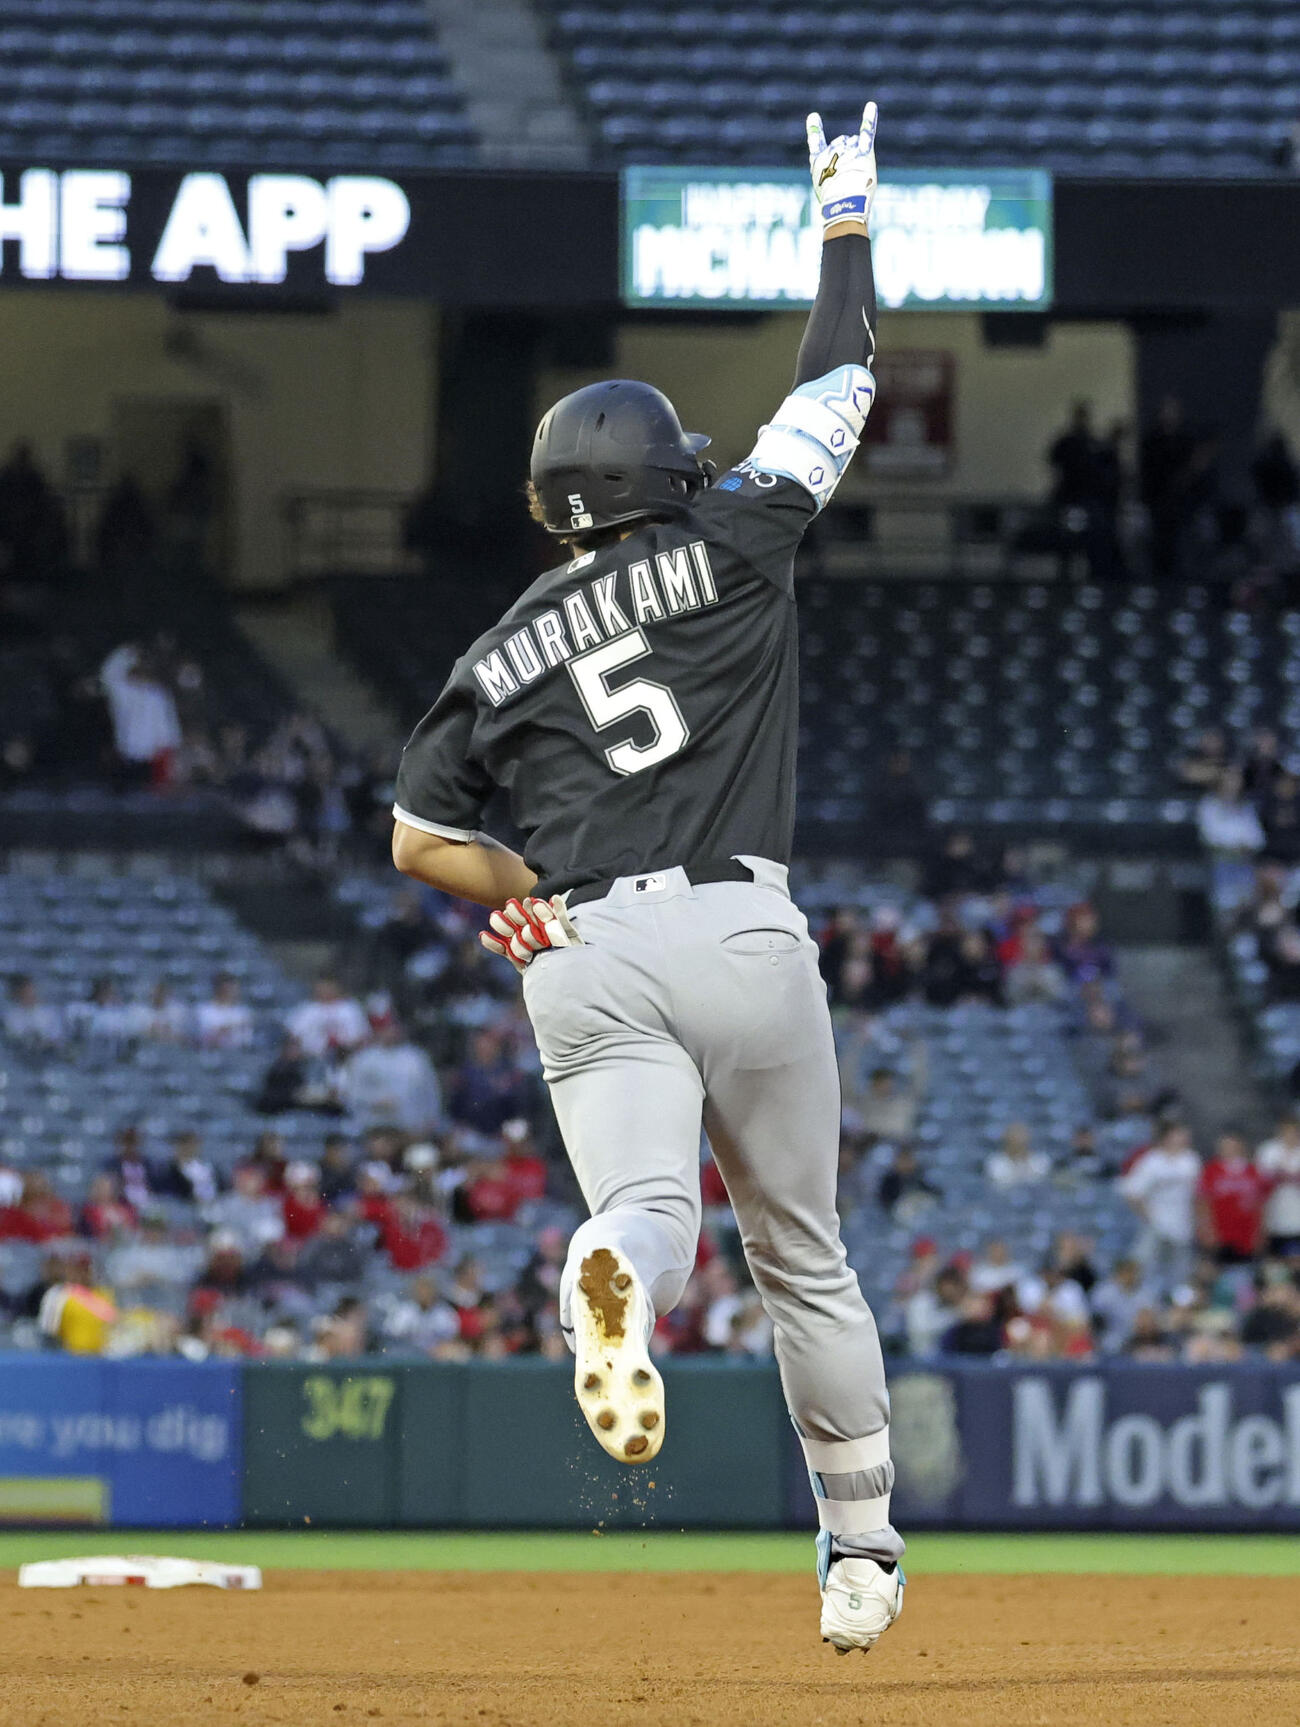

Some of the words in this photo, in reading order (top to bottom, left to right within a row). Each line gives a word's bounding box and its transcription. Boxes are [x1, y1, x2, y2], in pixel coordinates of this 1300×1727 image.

[0, 168, 131, 280] HE
[150, 172, 411, 286] APP
[568, 493, 585, 514] 5
[472, 540, 719, 708] MURAKAMI
[565, 624, 691, 776] 5
[50, 1410, 141, 1458] you
[147, 1402, 229, 1463] dig
[302, 1375, 395, 1440] 347
[848, 1592, 863, 1610] 5
